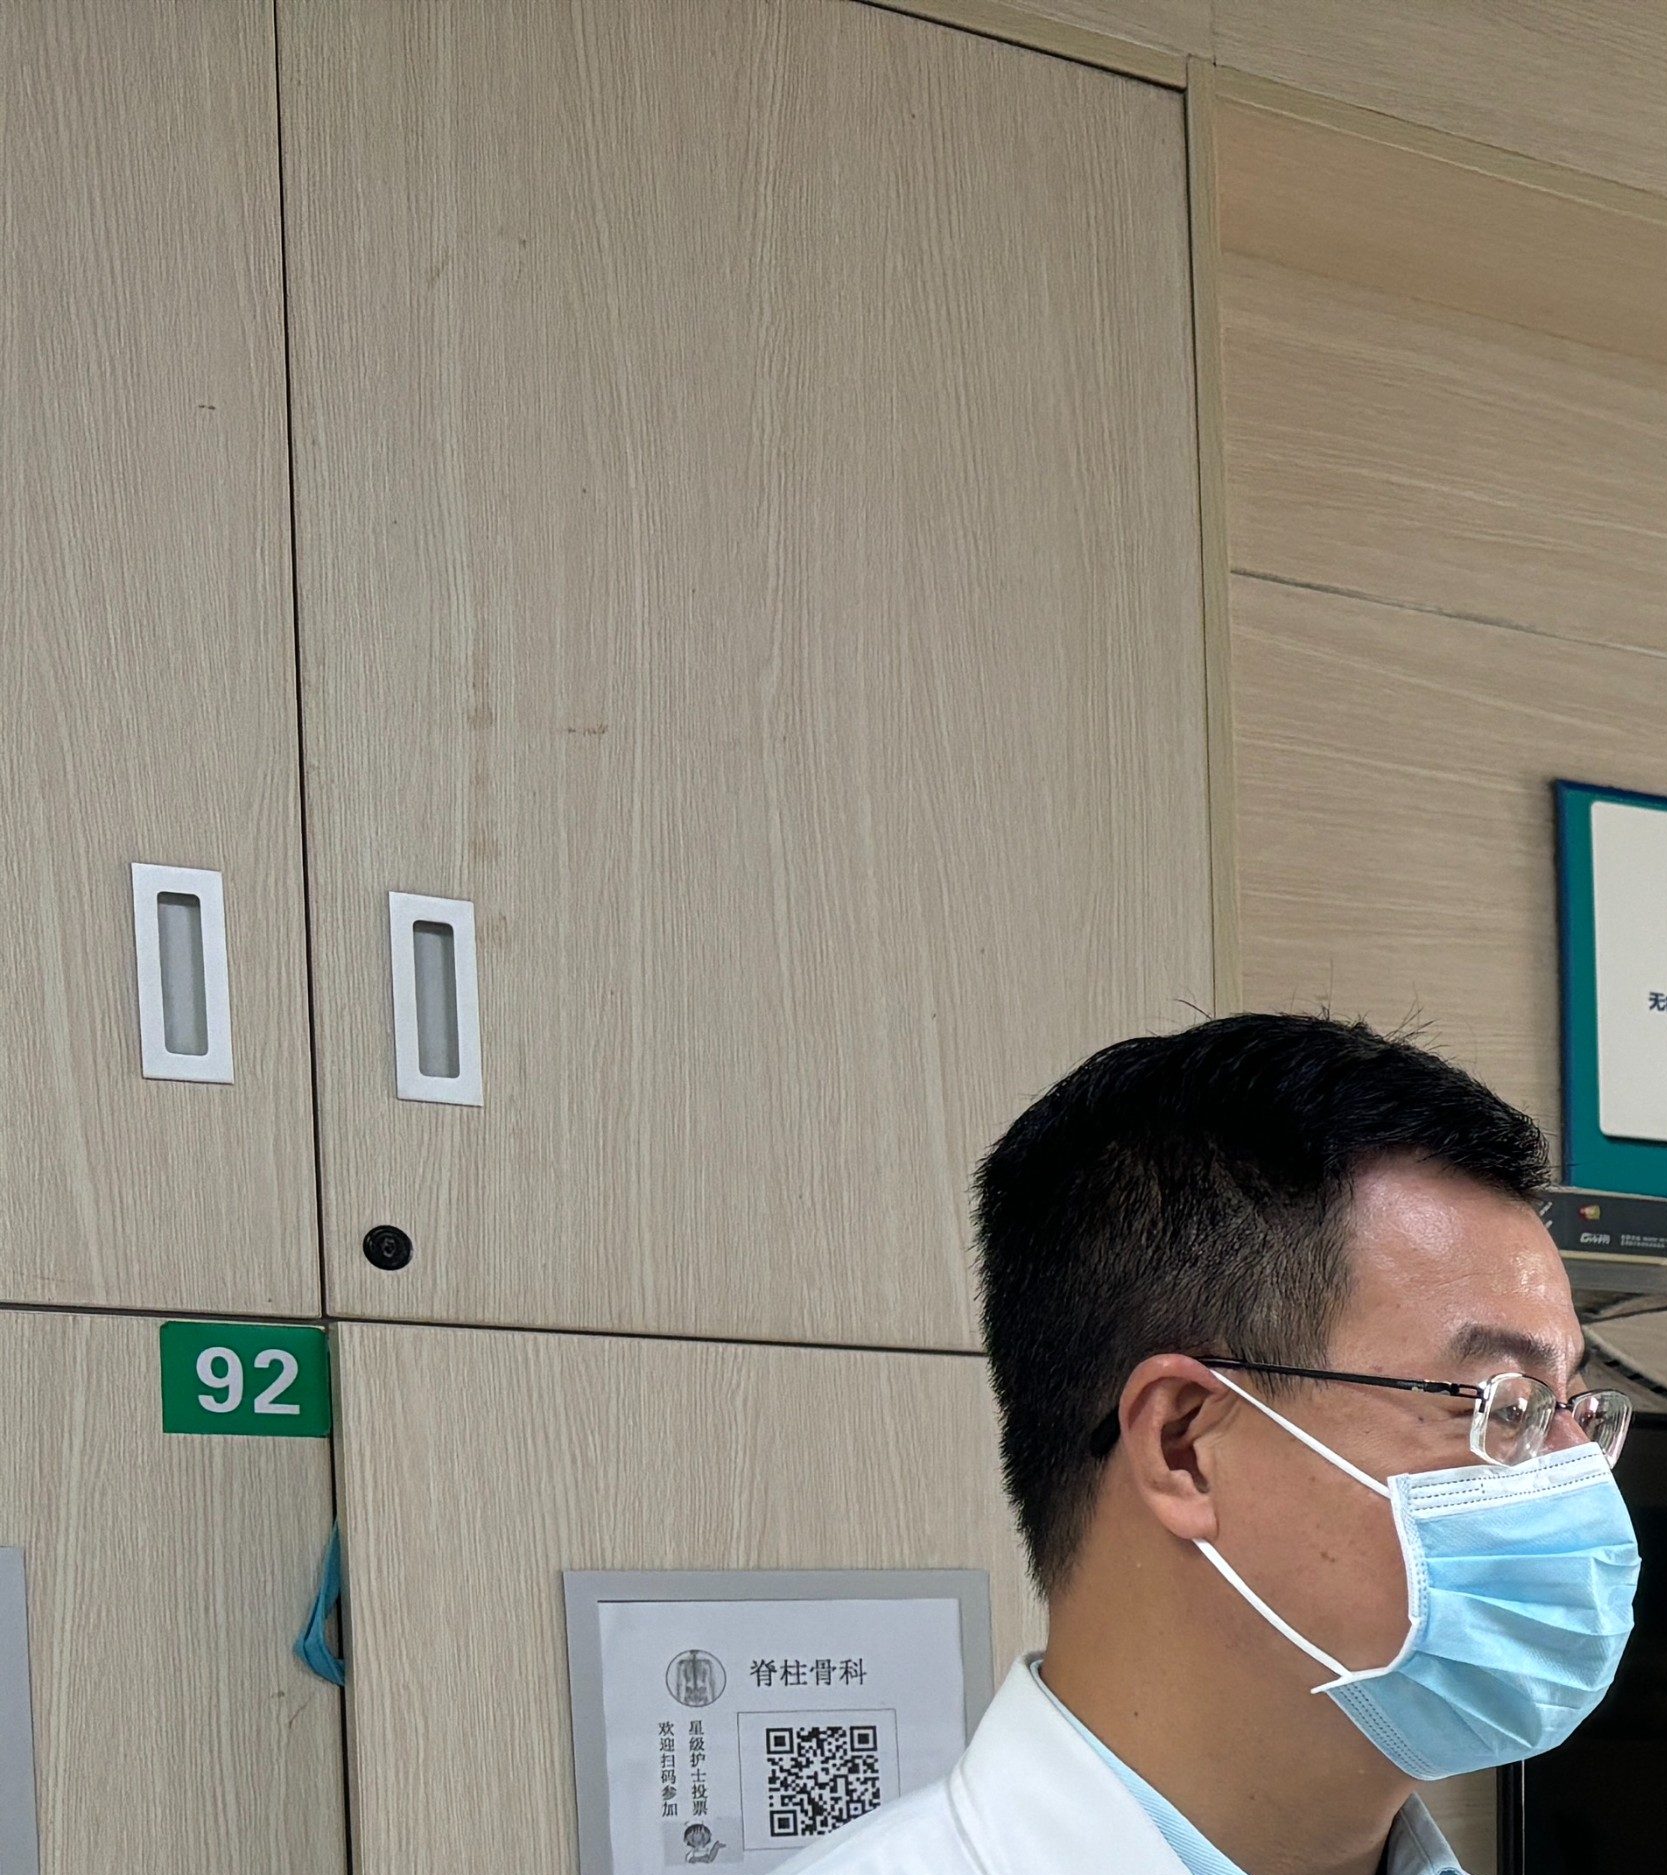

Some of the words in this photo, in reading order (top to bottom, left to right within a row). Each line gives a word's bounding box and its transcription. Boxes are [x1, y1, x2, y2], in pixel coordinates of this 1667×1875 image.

[194, 1346, 302, 1417] 92
[749, 1657, 868, 1688] 脊柱骨科
[657, 1720, 679, 1818] 欢迎扫码参加
[688, 1719, 709, 1817] 星级护士投票
